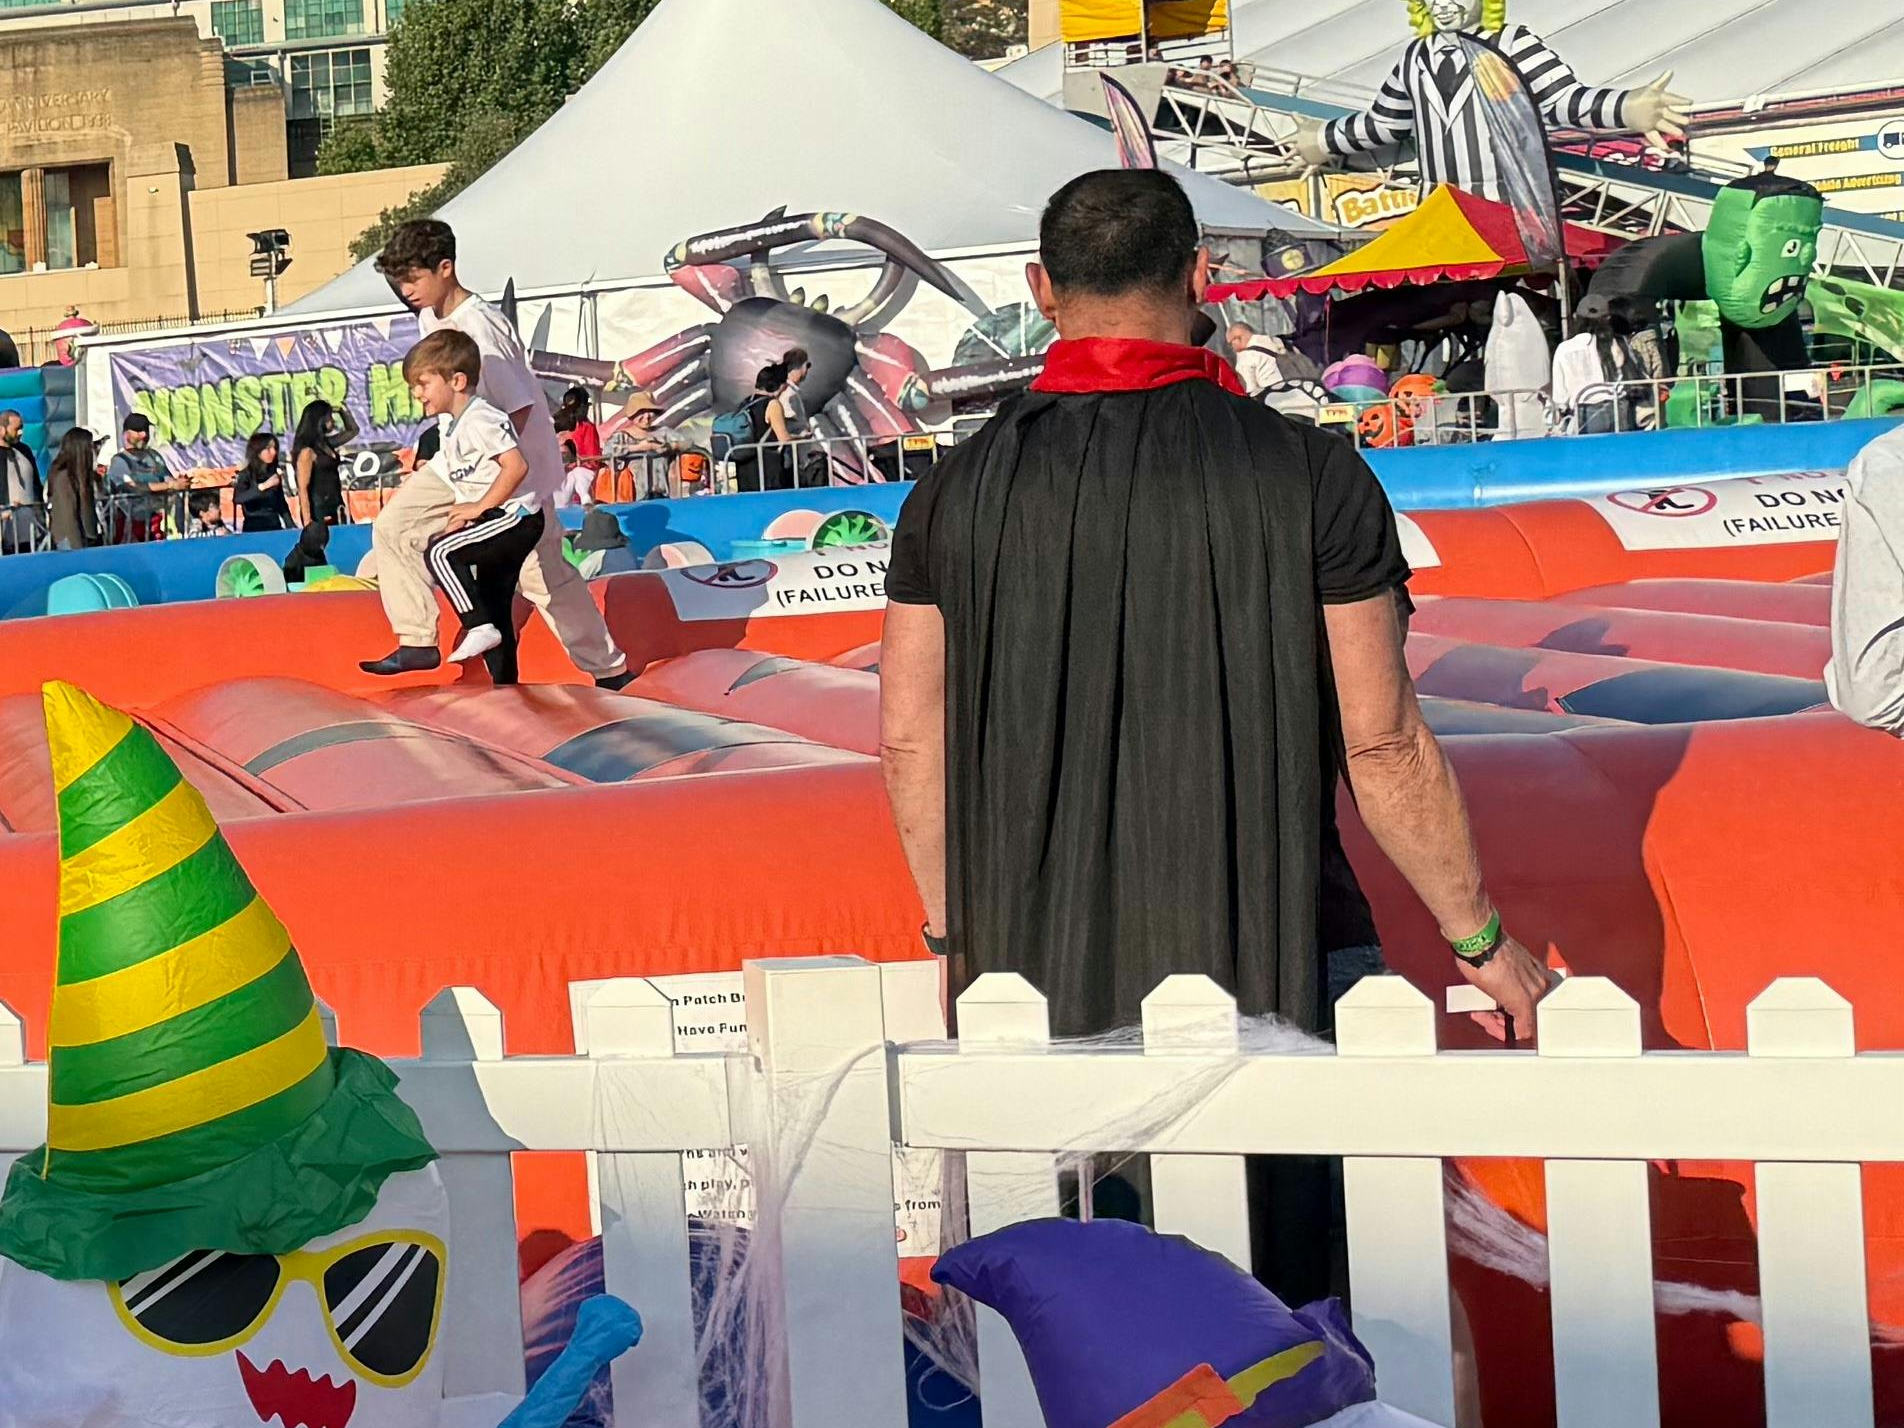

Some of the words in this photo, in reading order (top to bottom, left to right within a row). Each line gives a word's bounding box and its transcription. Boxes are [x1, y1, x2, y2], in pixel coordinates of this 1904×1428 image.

[1754, 491, 1806, 508] DO
[1724, 512, 1841, 537] (FAILURE
[813, 563, 858, 580] DO
[776, 583, 888, 608] (FAILURE
[904, 1199, 941, 1212] from
